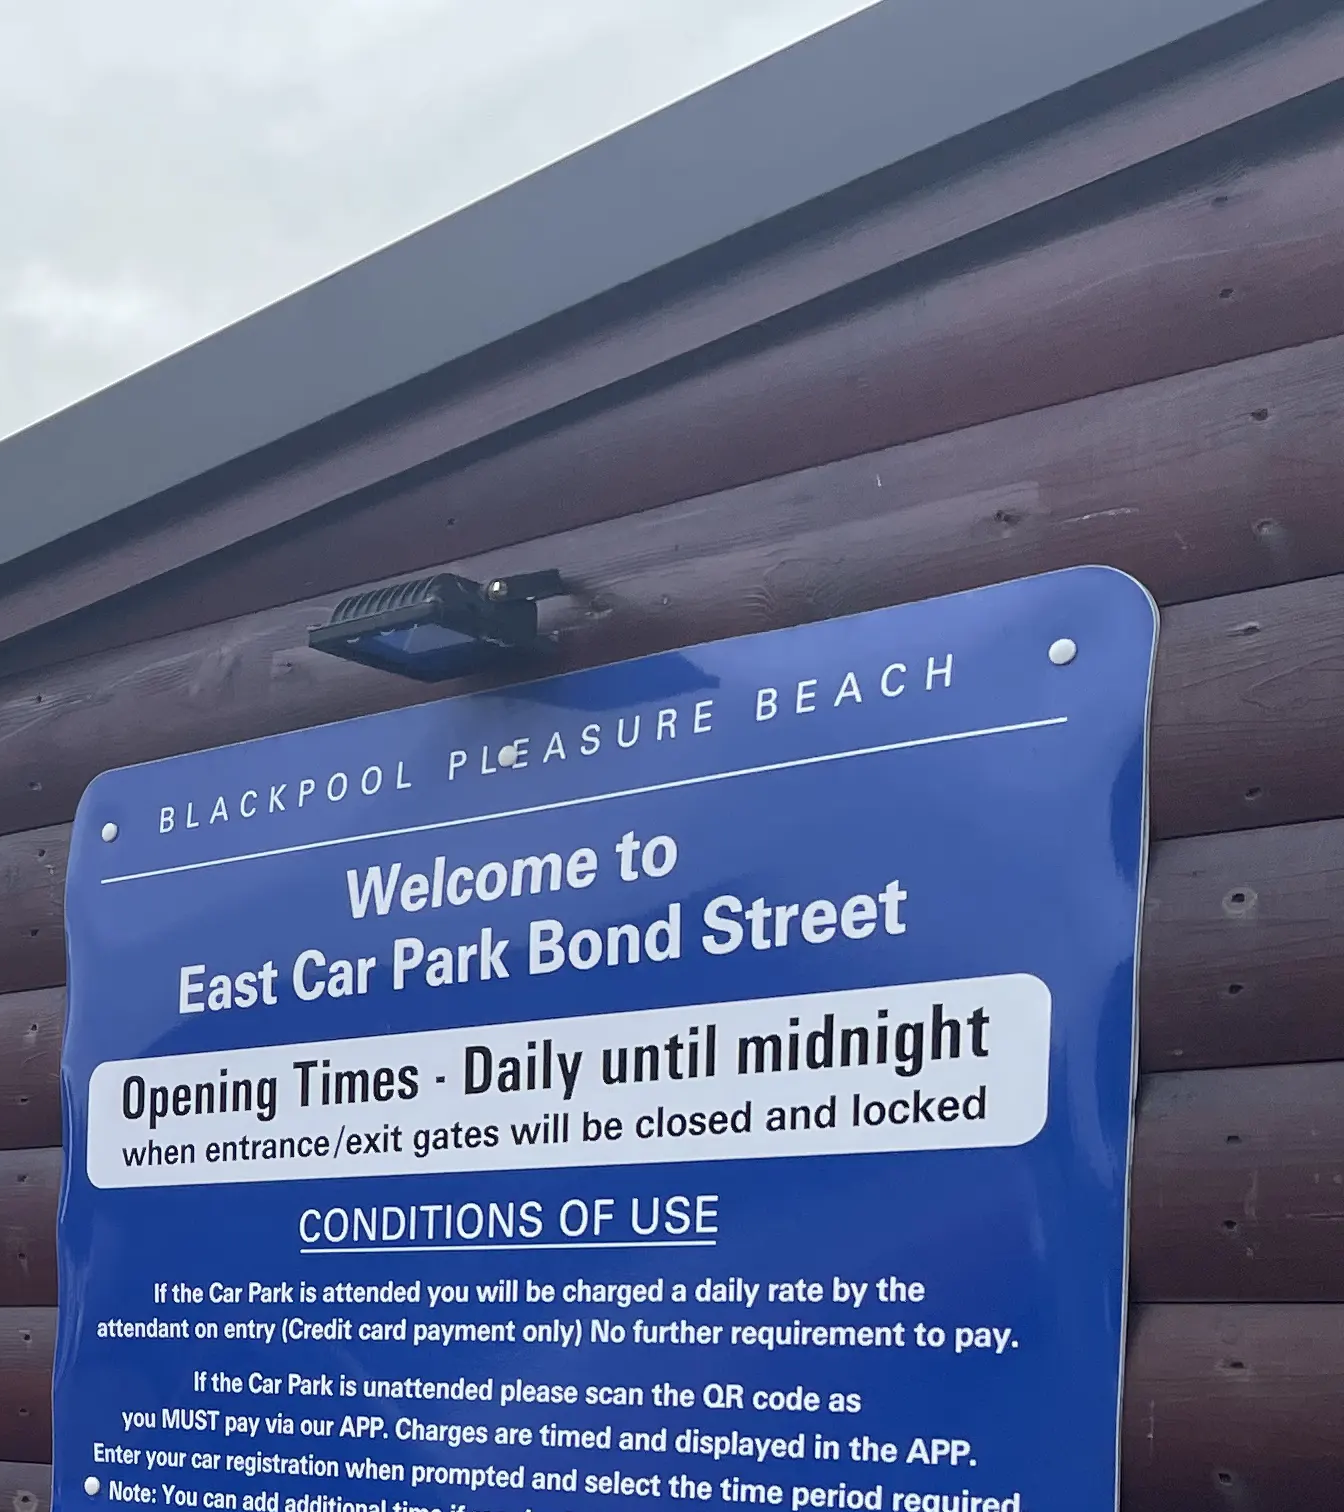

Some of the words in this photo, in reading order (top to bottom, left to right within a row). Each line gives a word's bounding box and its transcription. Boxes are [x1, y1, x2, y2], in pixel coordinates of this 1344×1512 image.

[159, 761, 412, 834] BLACKPOOL
[448, 699, 714, 781] PLEASURE
[755, 653, 953, 722] BEACH
[346, 847, 598, 919] Welcome
[615, 830, 678, 882] to
[179, 960, 279, 1014] East
[292, 949, 377, 1001] Car
[393, 926, 510, 991] Park
[528, 902, 681, 975] Bond
[701, 879, 908, 955] Street
[122, 1067, 278, 1131] Opening
[292, 1058, 419, 1108] Times
[464, 1038, 584, 1101] Daily
[602, 1023, 717, 1086] until
[737, 1002, 991, 1078] midnight
[121, 1138, 196, 1168] when
[205, 1123, 403, 1164] entrance/exit
[412, 1121, 500, 1159] gates
[509, 1112, 570, 1146] will
[582, 1110, 624, 1143] be
[635, 1099, 752, 1140] closed
[765, 1094, 837, 1133] and
[852, 1084, 987, 1128] locked
[299, 1200, 543, 1243] CONDITIONS
[559, 1198, 615, 1237] OF
[631, 1194, 719, 1236] USE
[154, 1282, 168, 1304] If
[171, 1282, 204, 1304] the
[208, 1281, 244, 1304] Car
[248, 1281, 294, 1304] Park
[299, 1280, 318, 1304] is
[322, 1279, 421, 1304] attended
[426, 1284, 470, 1309] you
[475, 1278, 519, 1303] will
[525, 1278, 556, 1303] be
[562, 1277, 664, 1309] charged
[670, 1283, 687, 1303] a
[694, 1276, 761, 1309] daily
[767, 1278, 824, 1303] rate
[832, 1276, 869, 1309] by
[875, 1275, 926, 1303] the
[93, 1442, 142, 1465] Enter
[145, 1449, 188, 1471] your
[190, 1452, 222, 1470] car
[225, 1450, 340, 1478] registration
[344, 1456, 405, 1482] when
[411, 1464, 525, 1492] prompted
[531, 1467, 578, 1493] and
[584, 1470, 662, 1498] select
[667, 1473, 713, 1501] the
[719, 1476, 784, 1505] time
[791, 1481, 883, 1512] period
